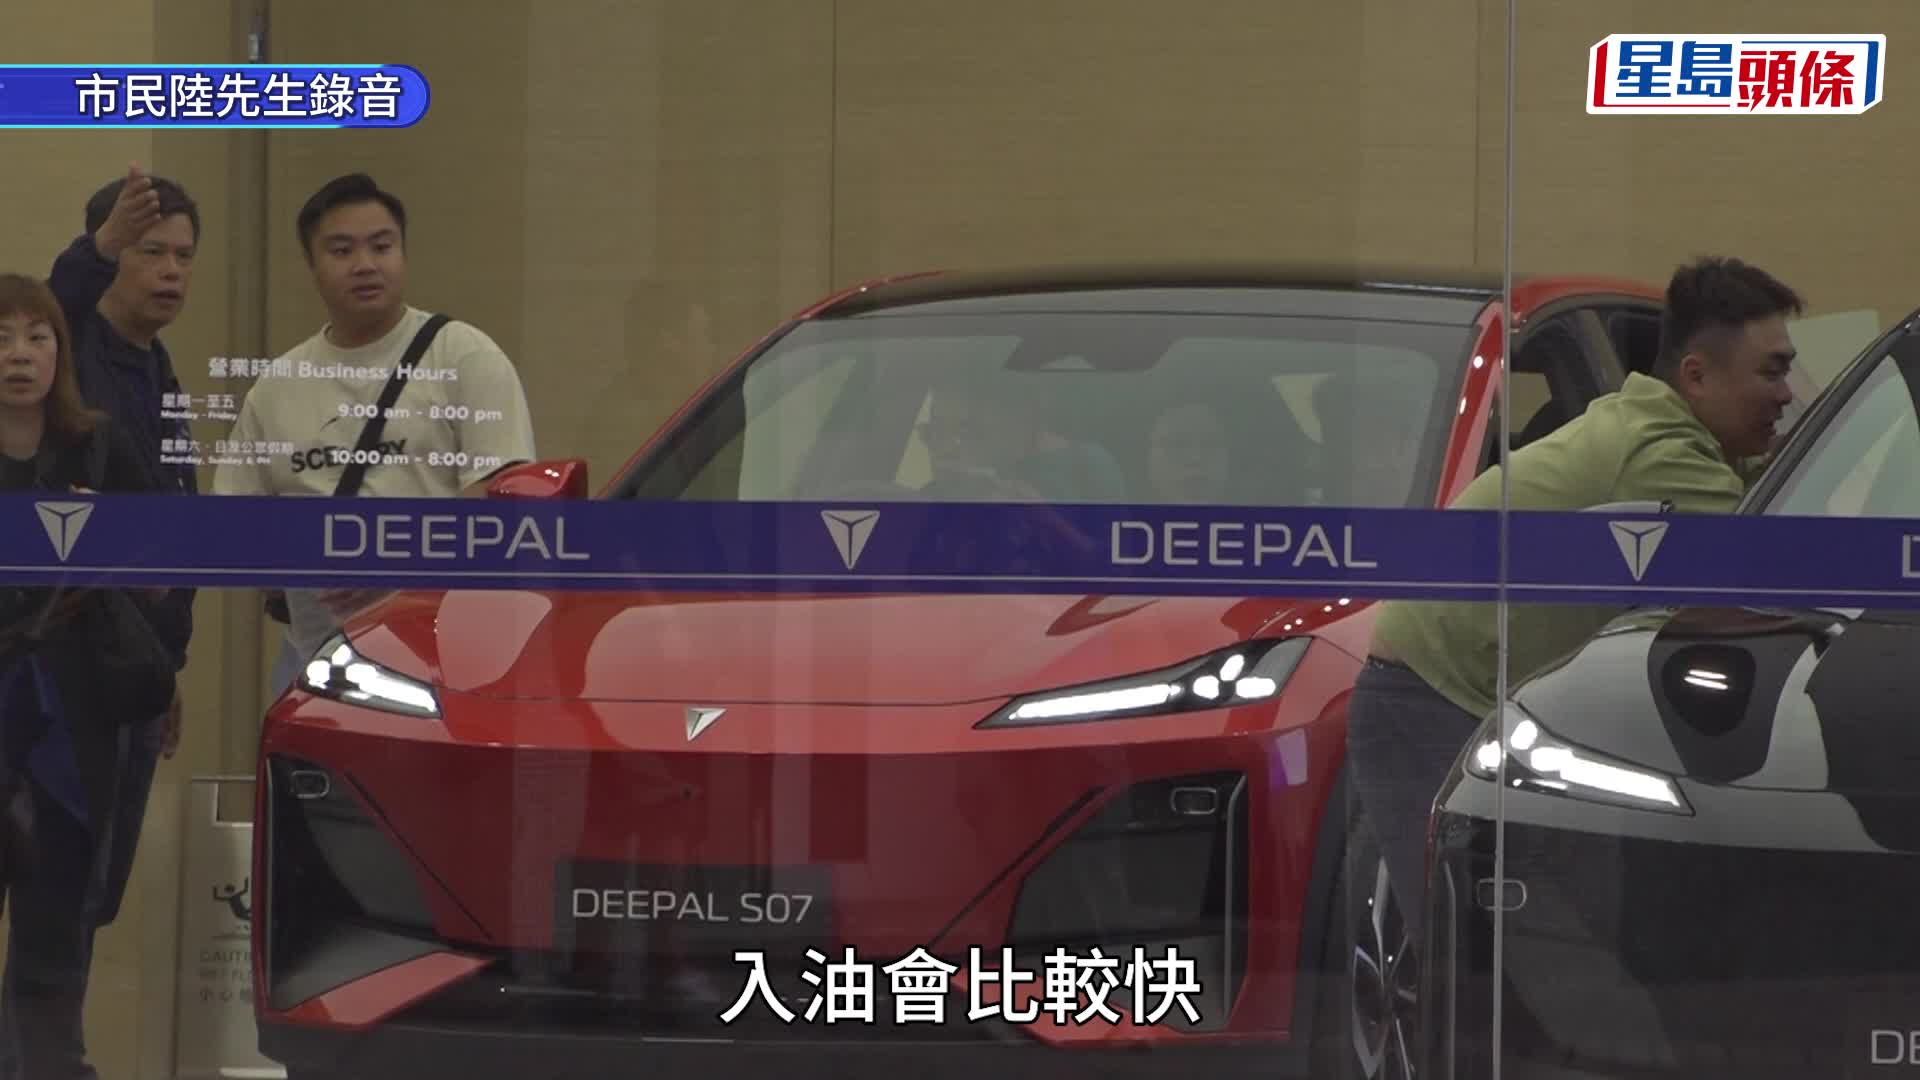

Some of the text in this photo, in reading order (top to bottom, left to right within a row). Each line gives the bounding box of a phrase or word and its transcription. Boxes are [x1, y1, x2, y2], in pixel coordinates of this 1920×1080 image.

[208, 358, 458, 382] 營業時間 Business Hours
[162, 393, 235, 409] 星期一至五
[338, 404, 378, 419] 9:00
[384, 407, 410, 419] am
[429, 405, 469, 420] 8:00
[474, 409, 503, 424] pm
[331, 449, 381, 465] 10:00
[382, 453, 409, 465] am
[427, 451, 468, 467] 8:00
[473, 455, 502, 470] pm
[324, 513, 590, 560] DEEPAL
[1111, 520, 1378, 568] DEEPAL
[572, 888, 813, 925] DEEPAL S07
